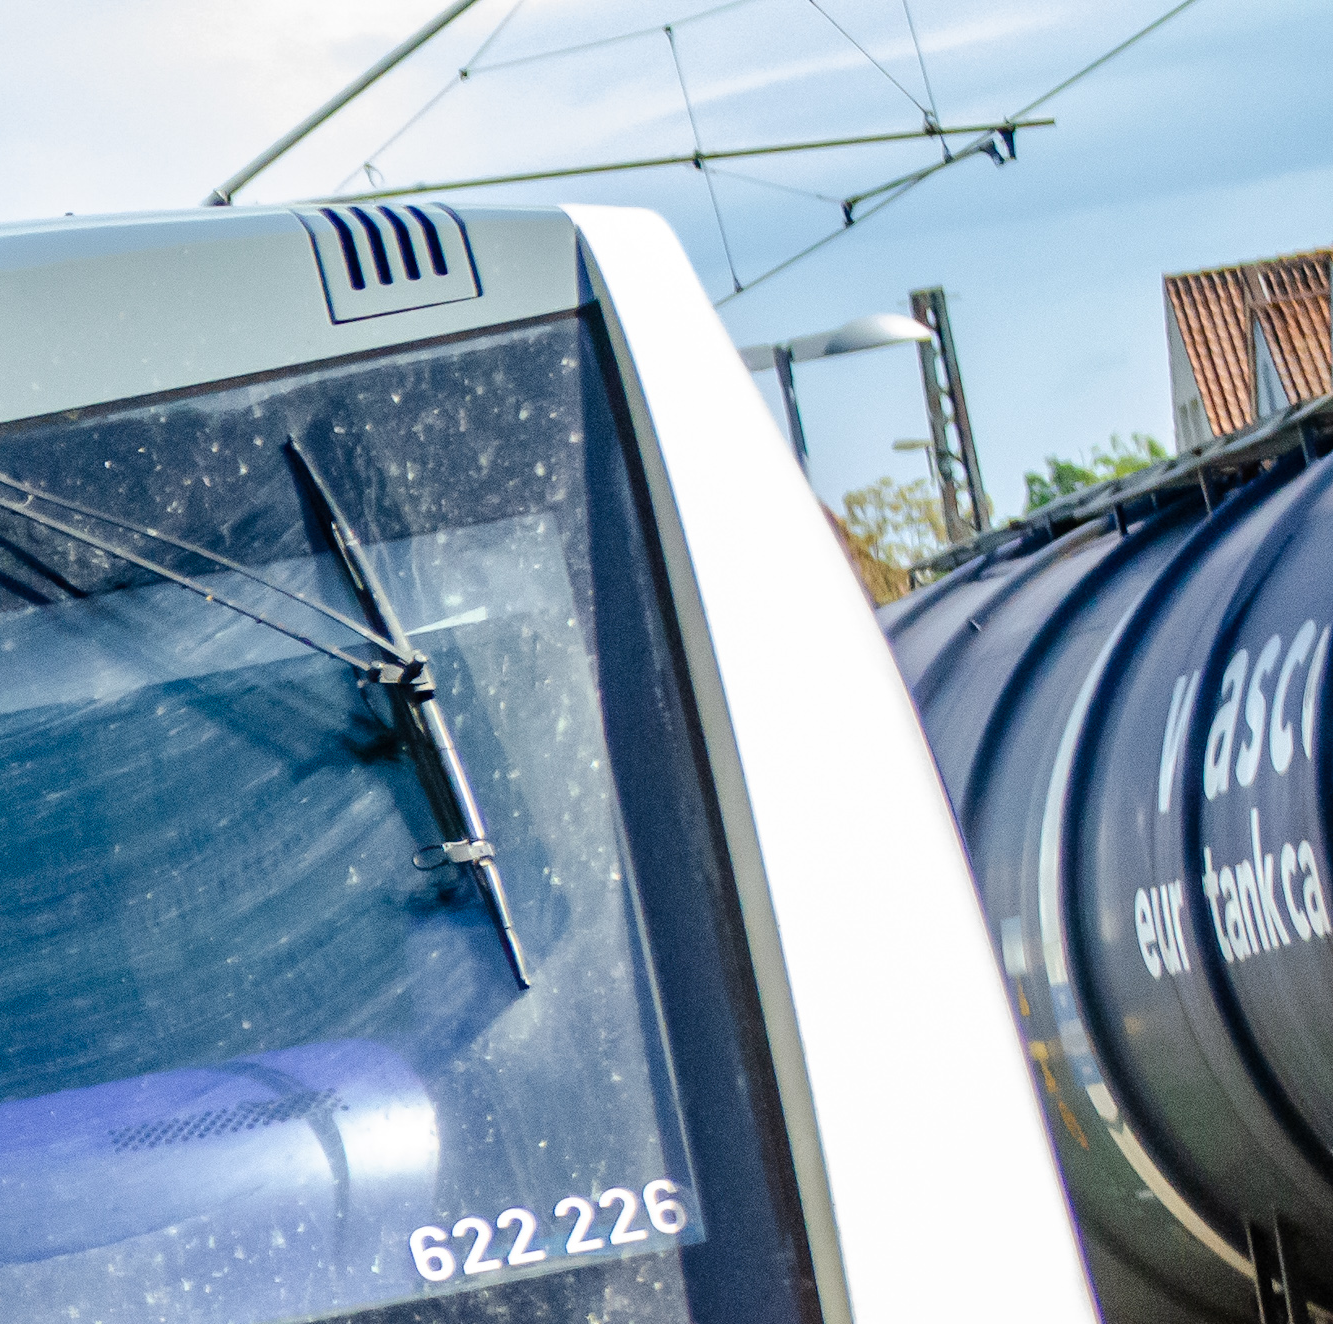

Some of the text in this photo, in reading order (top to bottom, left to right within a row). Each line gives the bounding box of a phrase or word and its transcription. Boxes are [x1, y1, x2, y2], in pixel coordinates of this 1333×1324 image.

[1134, 807, 1333, 981] eur tank ca
[408, 1178, 688, 1283] 622 226
